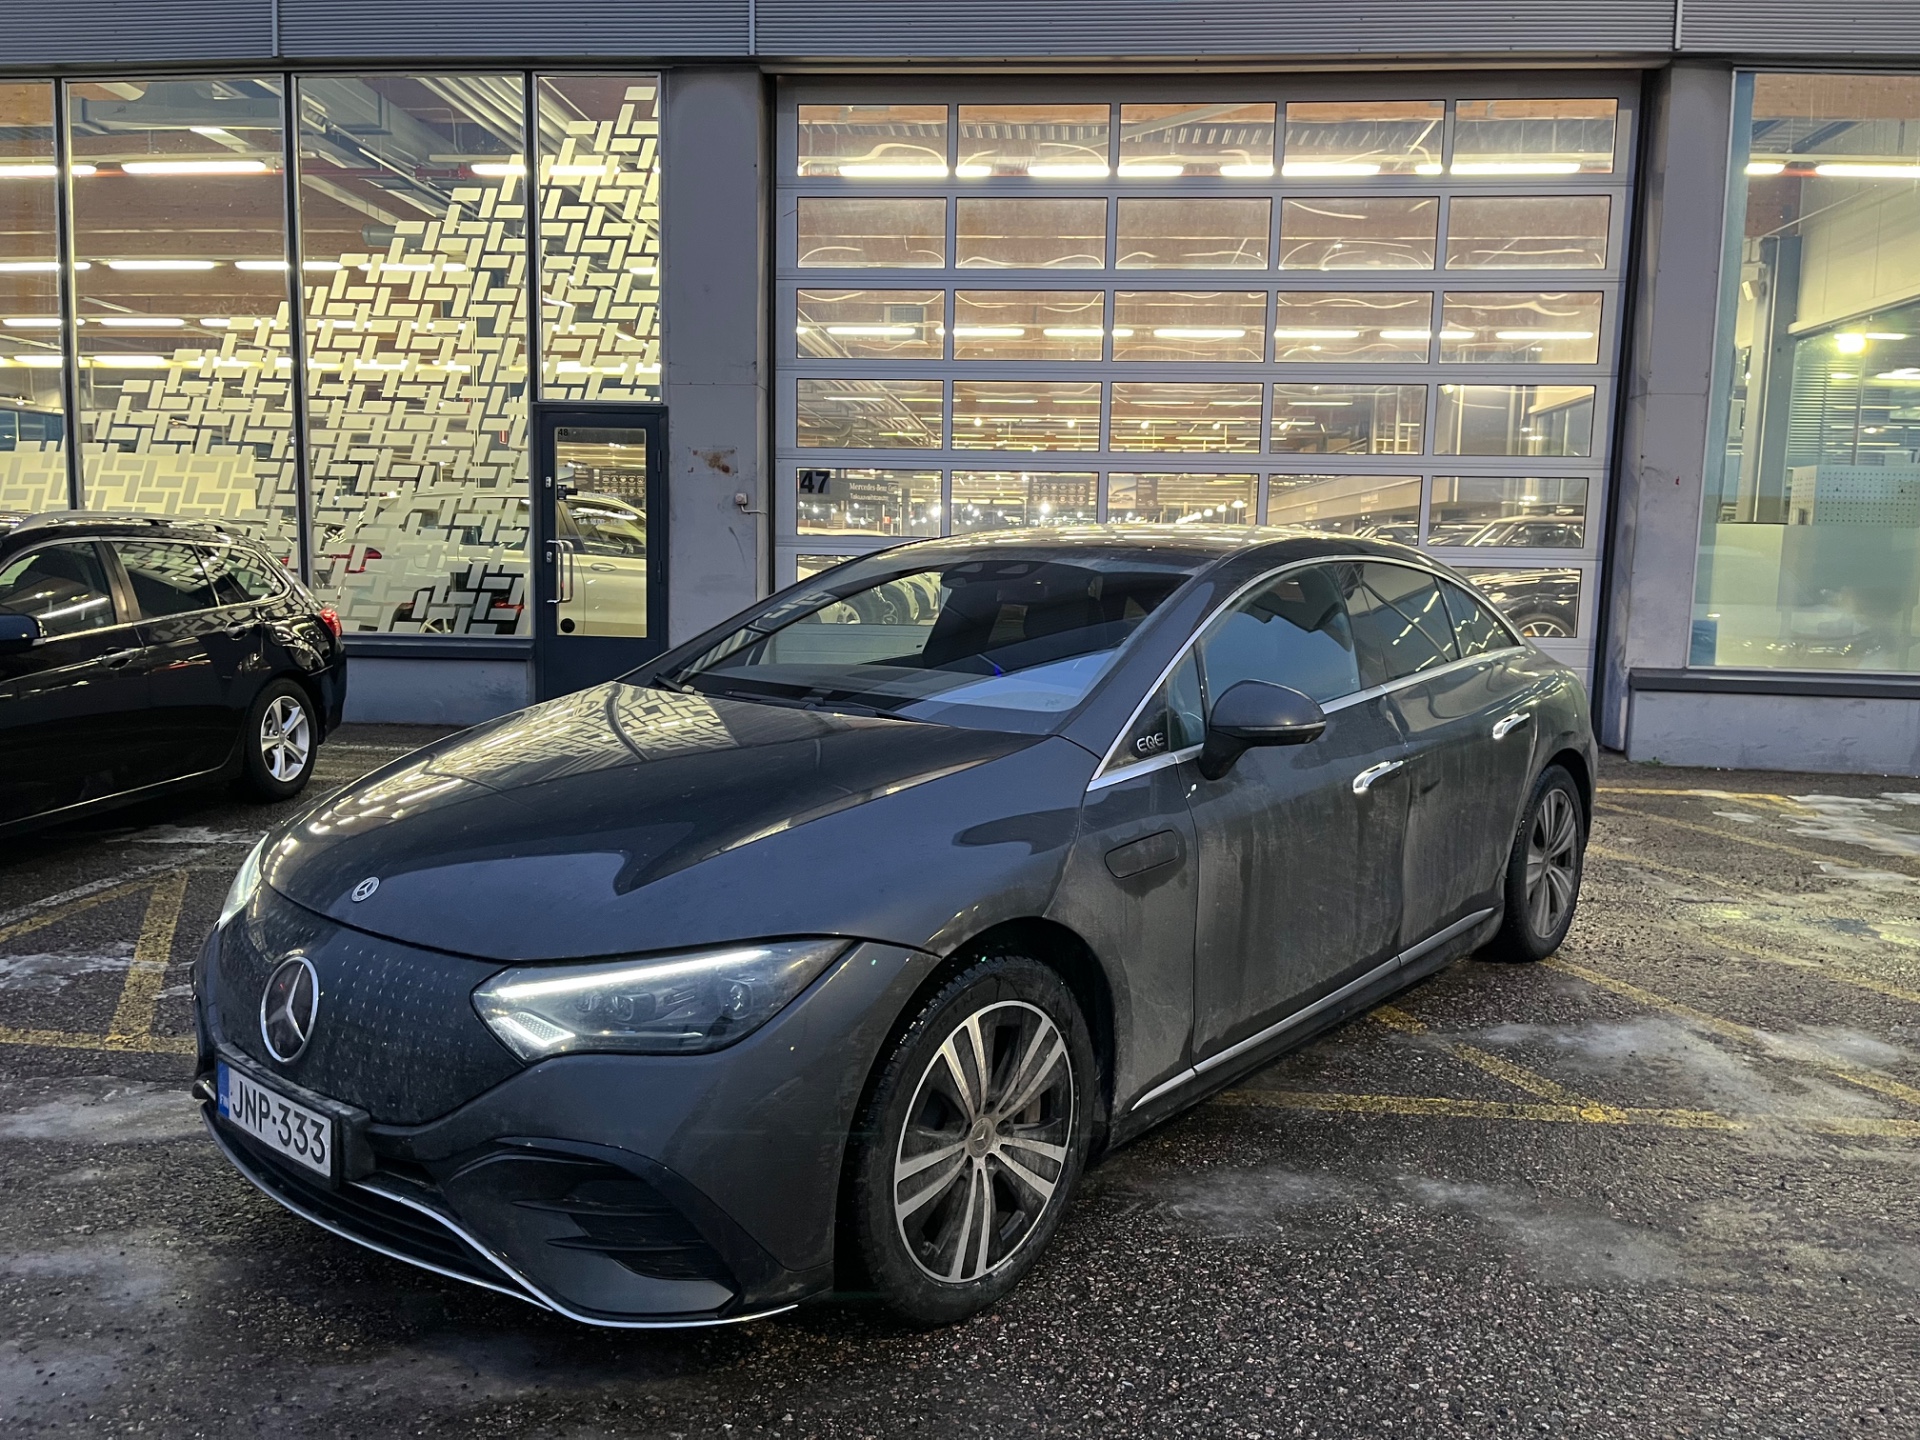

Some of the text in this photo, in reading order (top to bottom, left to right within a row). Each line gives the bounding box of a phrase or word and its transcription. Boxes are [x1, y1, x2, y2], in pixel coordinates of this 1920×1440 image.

[557, 428, 569, 436] 48
[1909, 448, 1920, 464] T
[800, 470, 830, 494] 47
[849, 482, 887, 492] Mercedes-Benz
[1136, 732, 1164, 752] EQE
[232, 1080, 325, 1164] JNP-333
